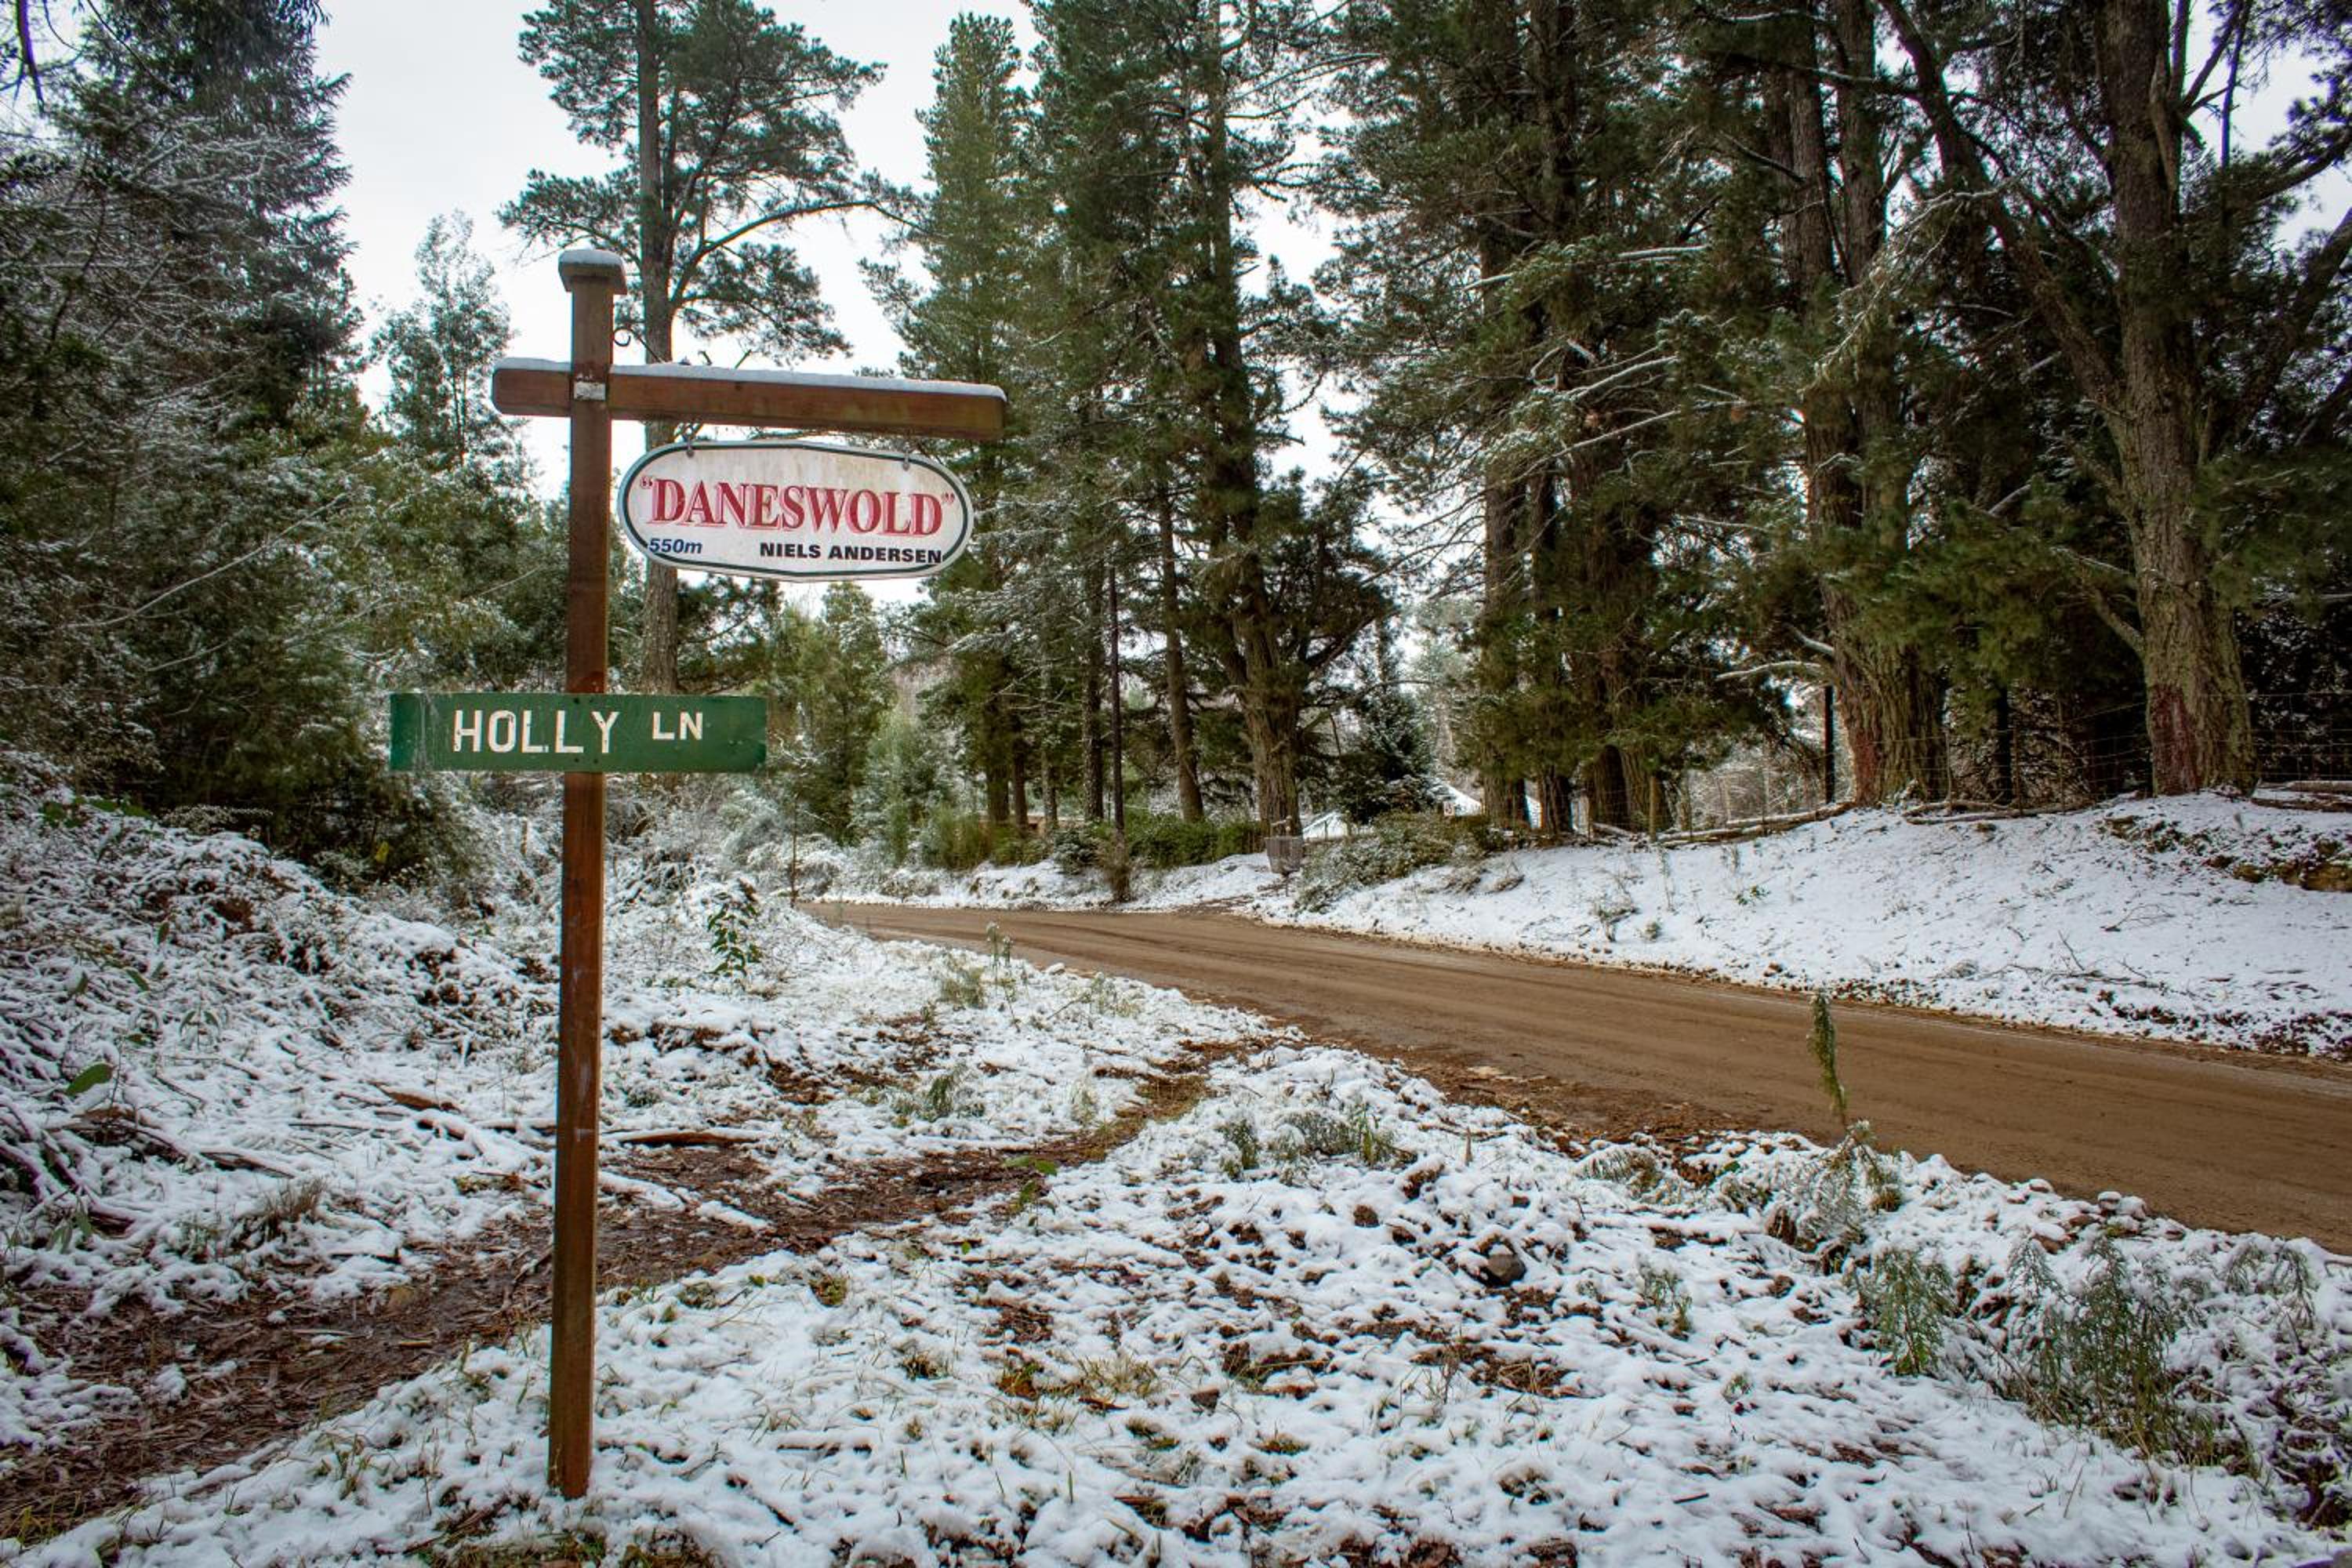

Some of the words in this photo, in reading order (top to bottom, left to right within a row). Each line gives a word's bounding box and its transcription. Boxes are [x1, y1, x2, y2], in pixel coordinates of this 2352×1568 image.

[649, 538, 703, 554] 550m
[760, 542, 821, 558] NIELS
[828, 546, 942, 564] ANDERSEN
[453, 710, 620, 753] HOLLY
[652, 711, 703, 741] LN
